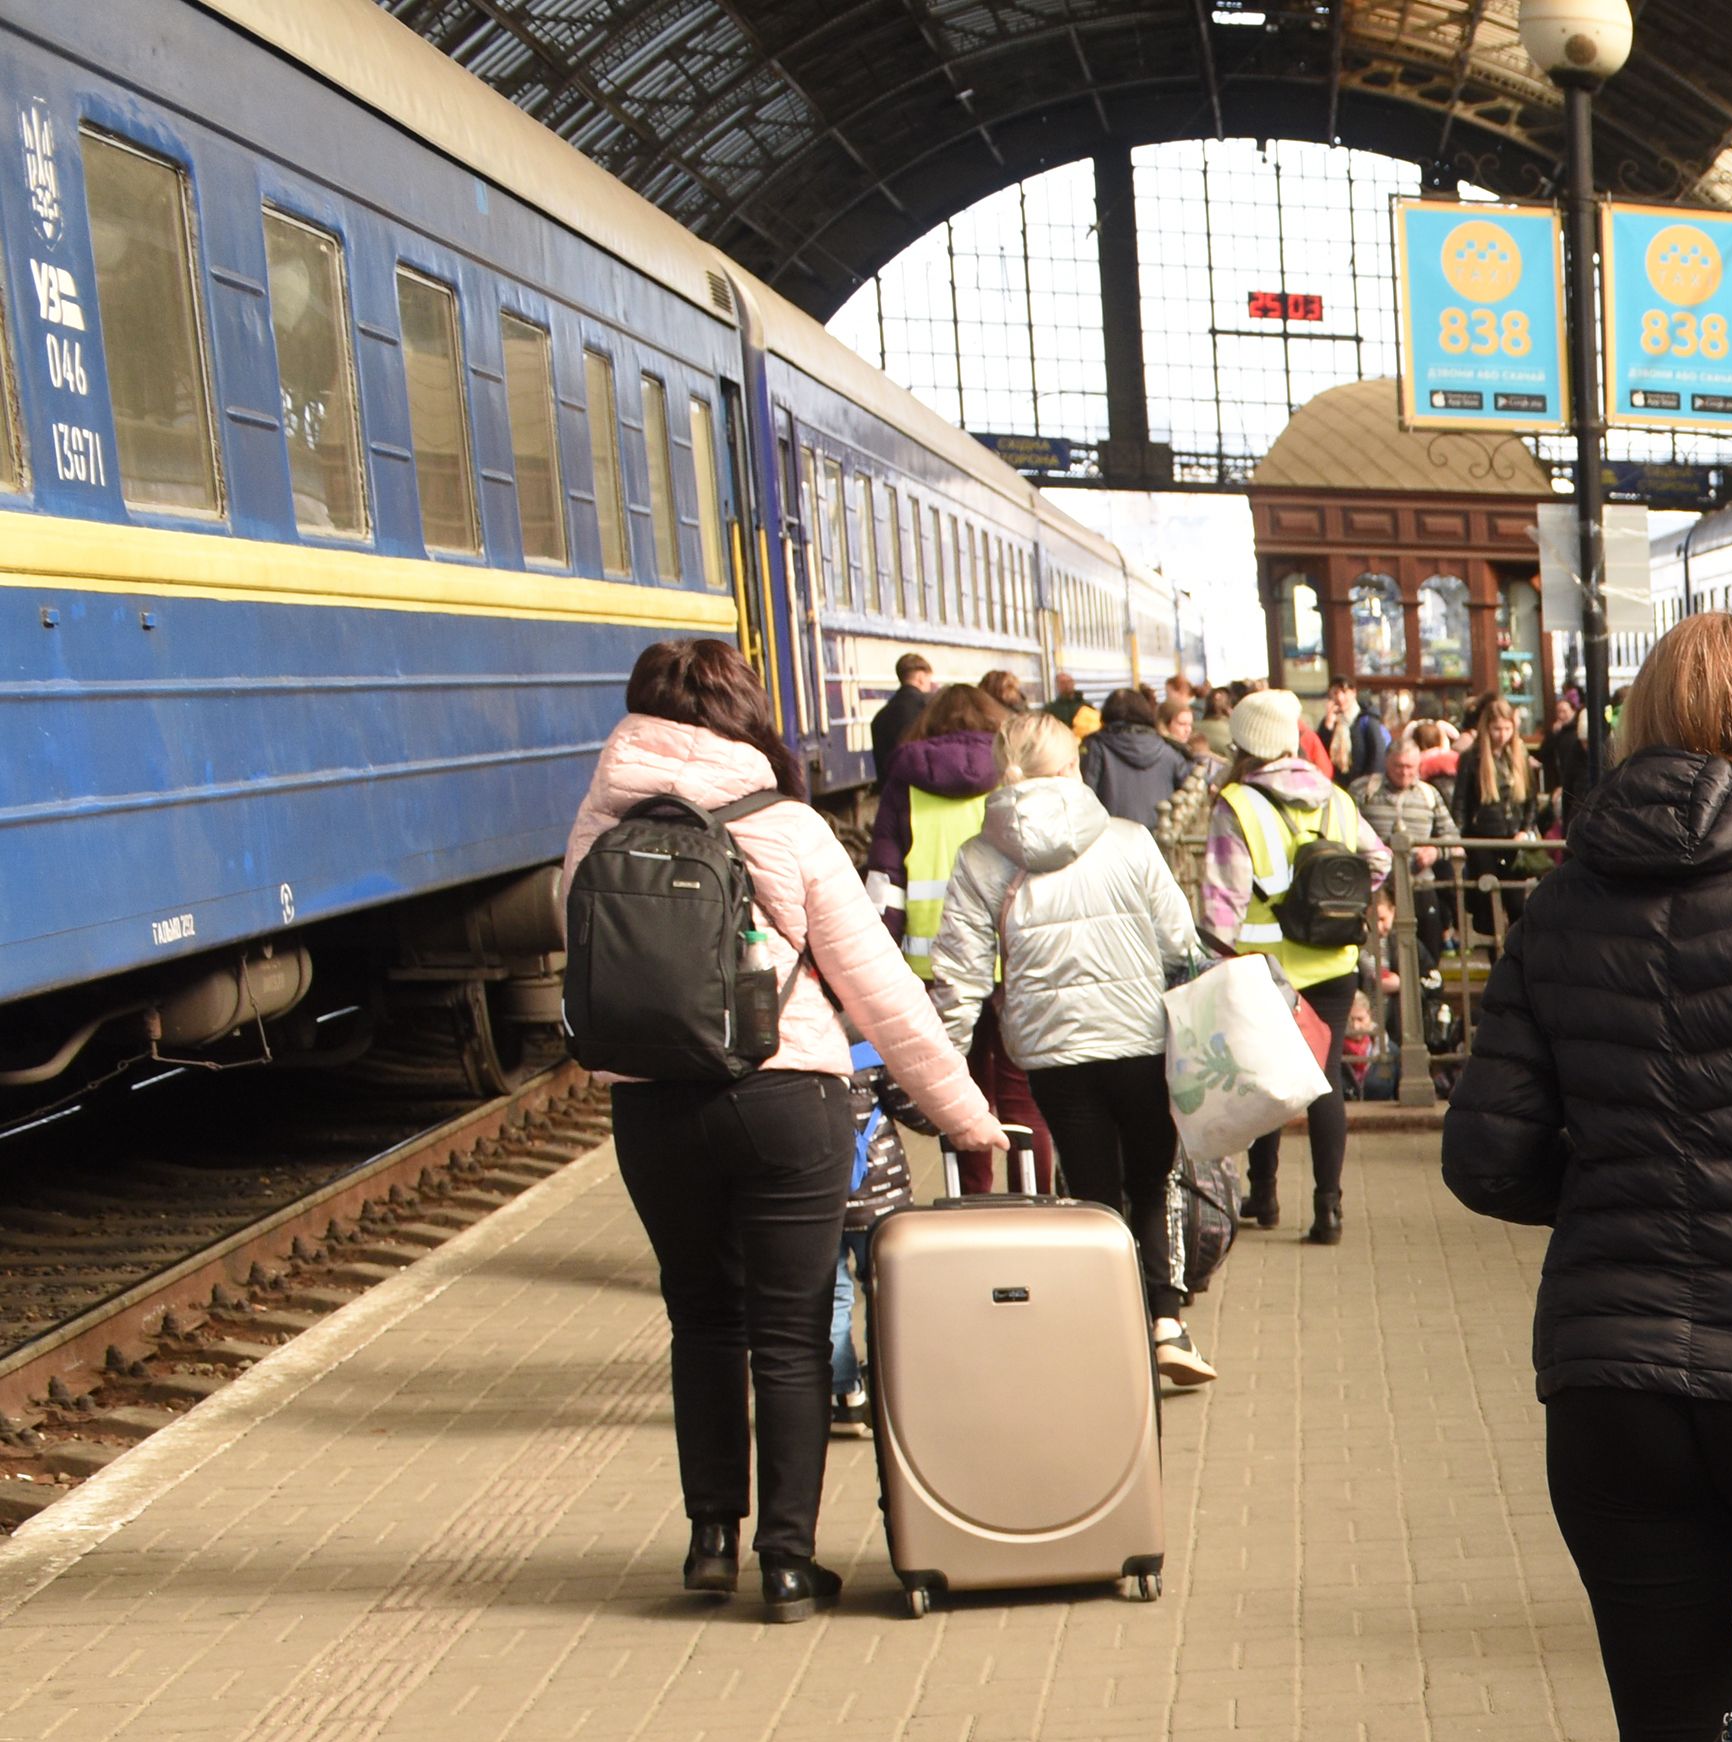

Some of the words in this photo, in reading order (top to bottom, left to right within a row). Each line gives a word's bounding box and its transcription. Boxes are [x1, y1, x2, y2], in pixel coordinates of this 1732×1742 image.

[1455, 266, 1513, 285] TAXI
[1439, 307, 1532, 357] 838
[1640, 309, 1729, 360] 838
[46, 333, 88, 395] 046
[52, 423, 106, 486] 13071
